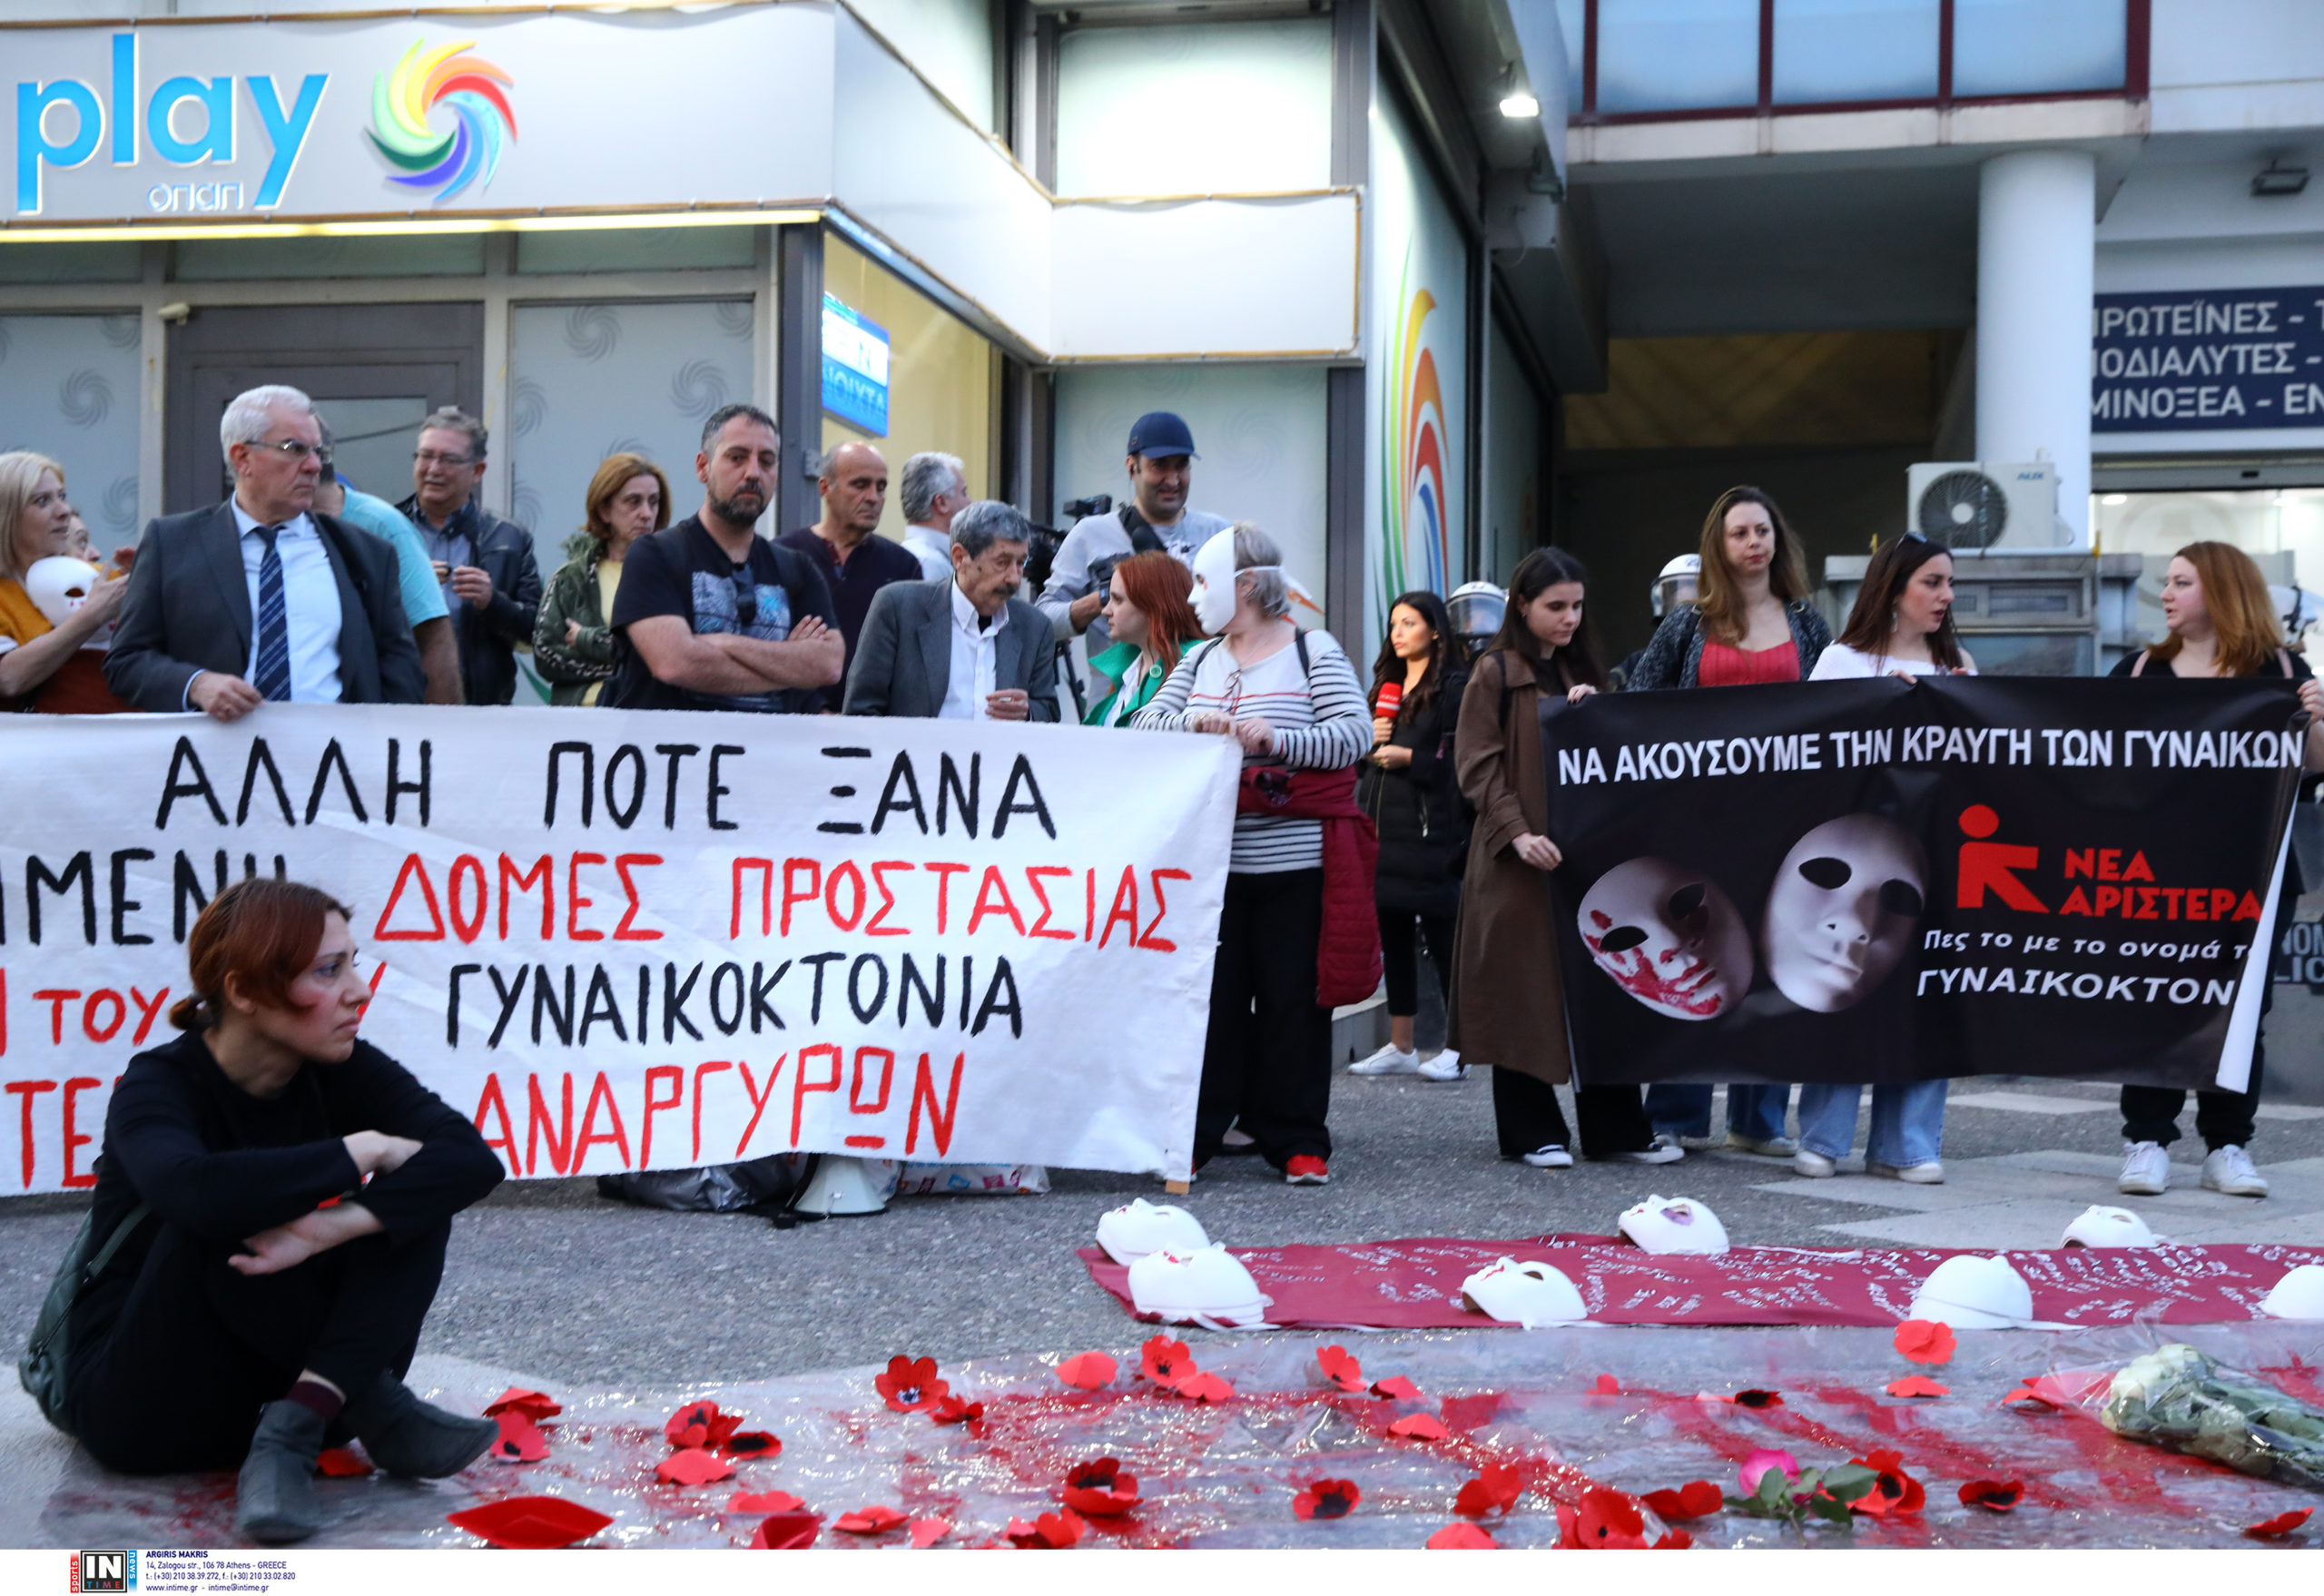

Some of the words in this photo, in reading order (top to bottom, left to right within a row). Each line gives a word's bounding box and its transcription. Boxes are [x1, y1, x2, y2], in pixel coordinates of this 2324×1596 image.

[17, 33, 330, 214] play
[156, 735, 432, 830] ΑΛΛΗ
[544, 741, 745, 831] ΠΟΤΕ
[817, 746, 1058, 840] ΞΑΝΑ
[1558, 747, 1607, 785] ΝΑ
[1614, 733, 1822, 783] ΑΚΟΥΣΟΥΜΕ
[1829, 728, 1893, 769] ΤΗΝ
[1902, 725, 2032, 765] ΚΡΑΥΓΗ
[2041, 729, 2112, 767] ΤΩΝ
[2124, 730, 2303, 768] ΓΥΝΑΙΚΩΝ
[0, 849, 285, 946] ΜΕΝ
[373, 851, 665, 945] ΔΟΜΕΣ
[730, 857, 1192, 953] ΠΡΟΣΤΑΣΙΑΣ
[2058, 885, 2262, 922] ΑΡΙΣΤΕΡΑ
[2064, 848, 2155, 882] ΝΕΑ
[1924, 930, 1970, 951] Πες
[1980, 931, 2013, 948] το
[2023, 935, 2059, 953] με
[2073, 938, 2105, 955] το
[2119, 939, 2221, 962] ονομά
[33, 986, 170, 1047] ΤΟΥ
[447, 952, 1022, 1049] ΓΥΝΑΙΚΟΚΤΟΝΙΑ
